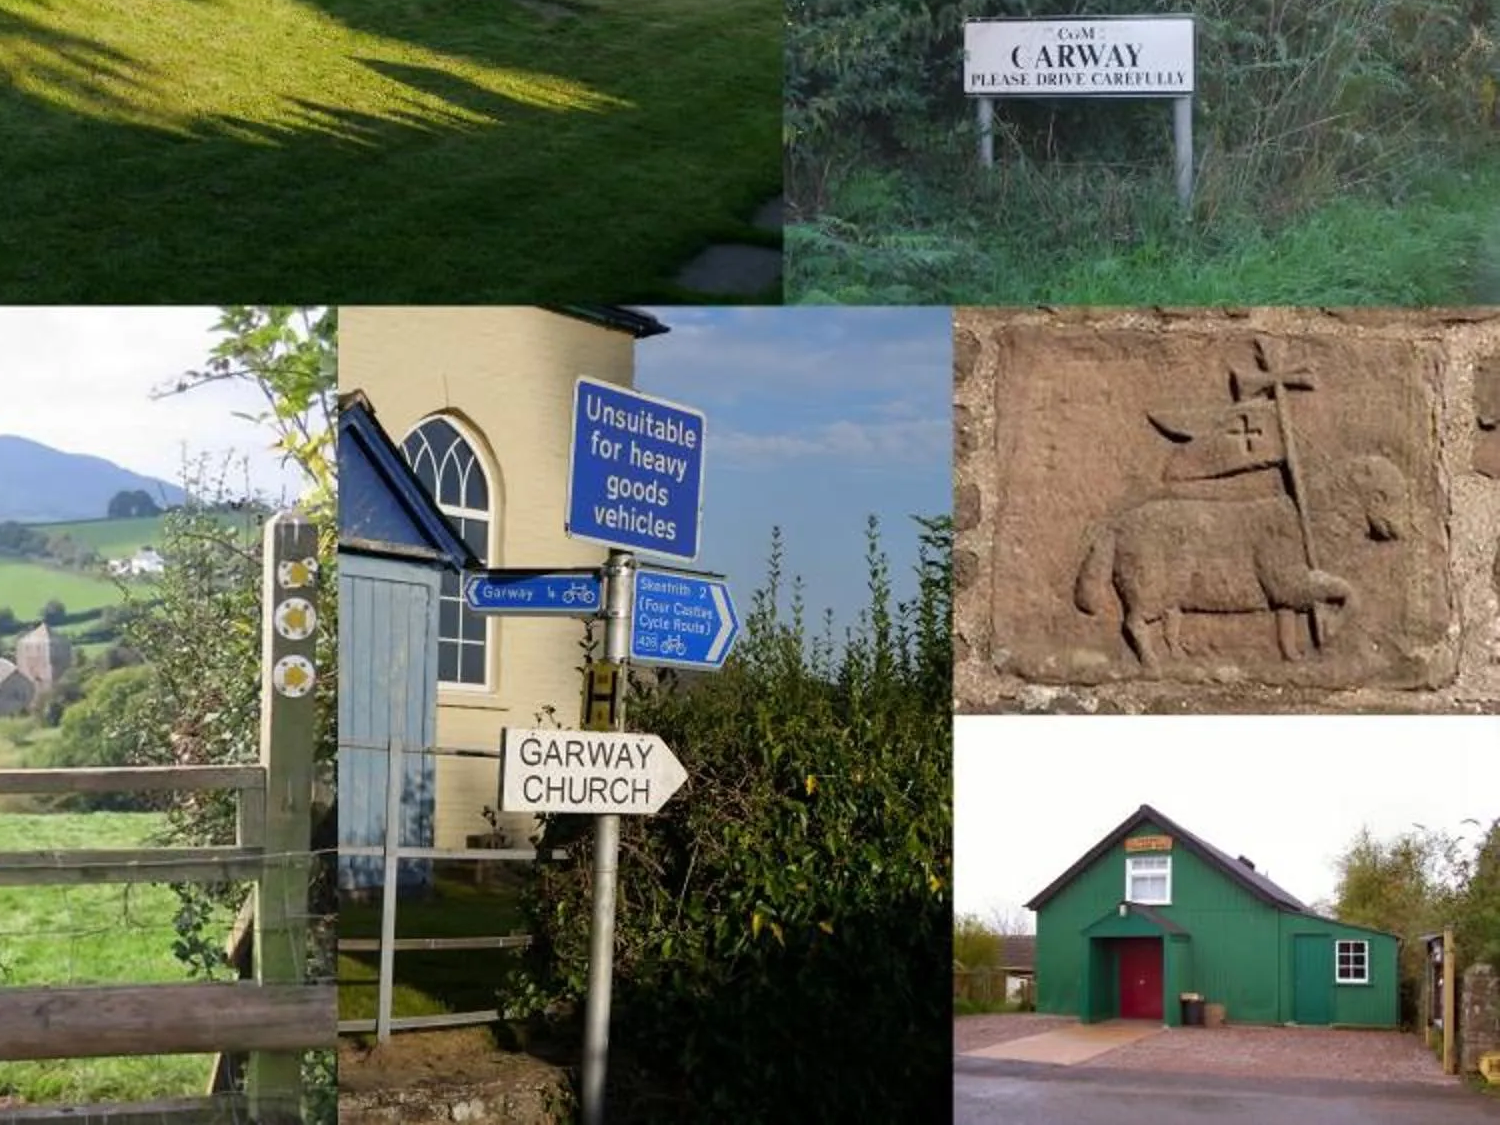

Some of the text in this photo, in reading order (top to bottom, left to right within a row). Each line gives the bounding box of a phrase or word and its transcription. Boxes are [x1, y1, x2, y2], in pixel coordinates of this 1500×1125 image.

[972, 72, 1185, 86] PLEASE DRIVE CAREFULLY
[587, 394, 697, 449] Unsuitable
[591, 430, 687, 483] for heavy
[607, 475, 669, 507] goods
[593, 504, 677, 540] vehicles
[483, 584, 533, 602] Garway
[639, 595, 670, 614] (Four
[699, 586, 707, 600] 2
[639, 613, 711, 636] Cycle Route)
[519, 738, 653, 769] GARWAY
[523, 775, 650, 804] CHURCH
